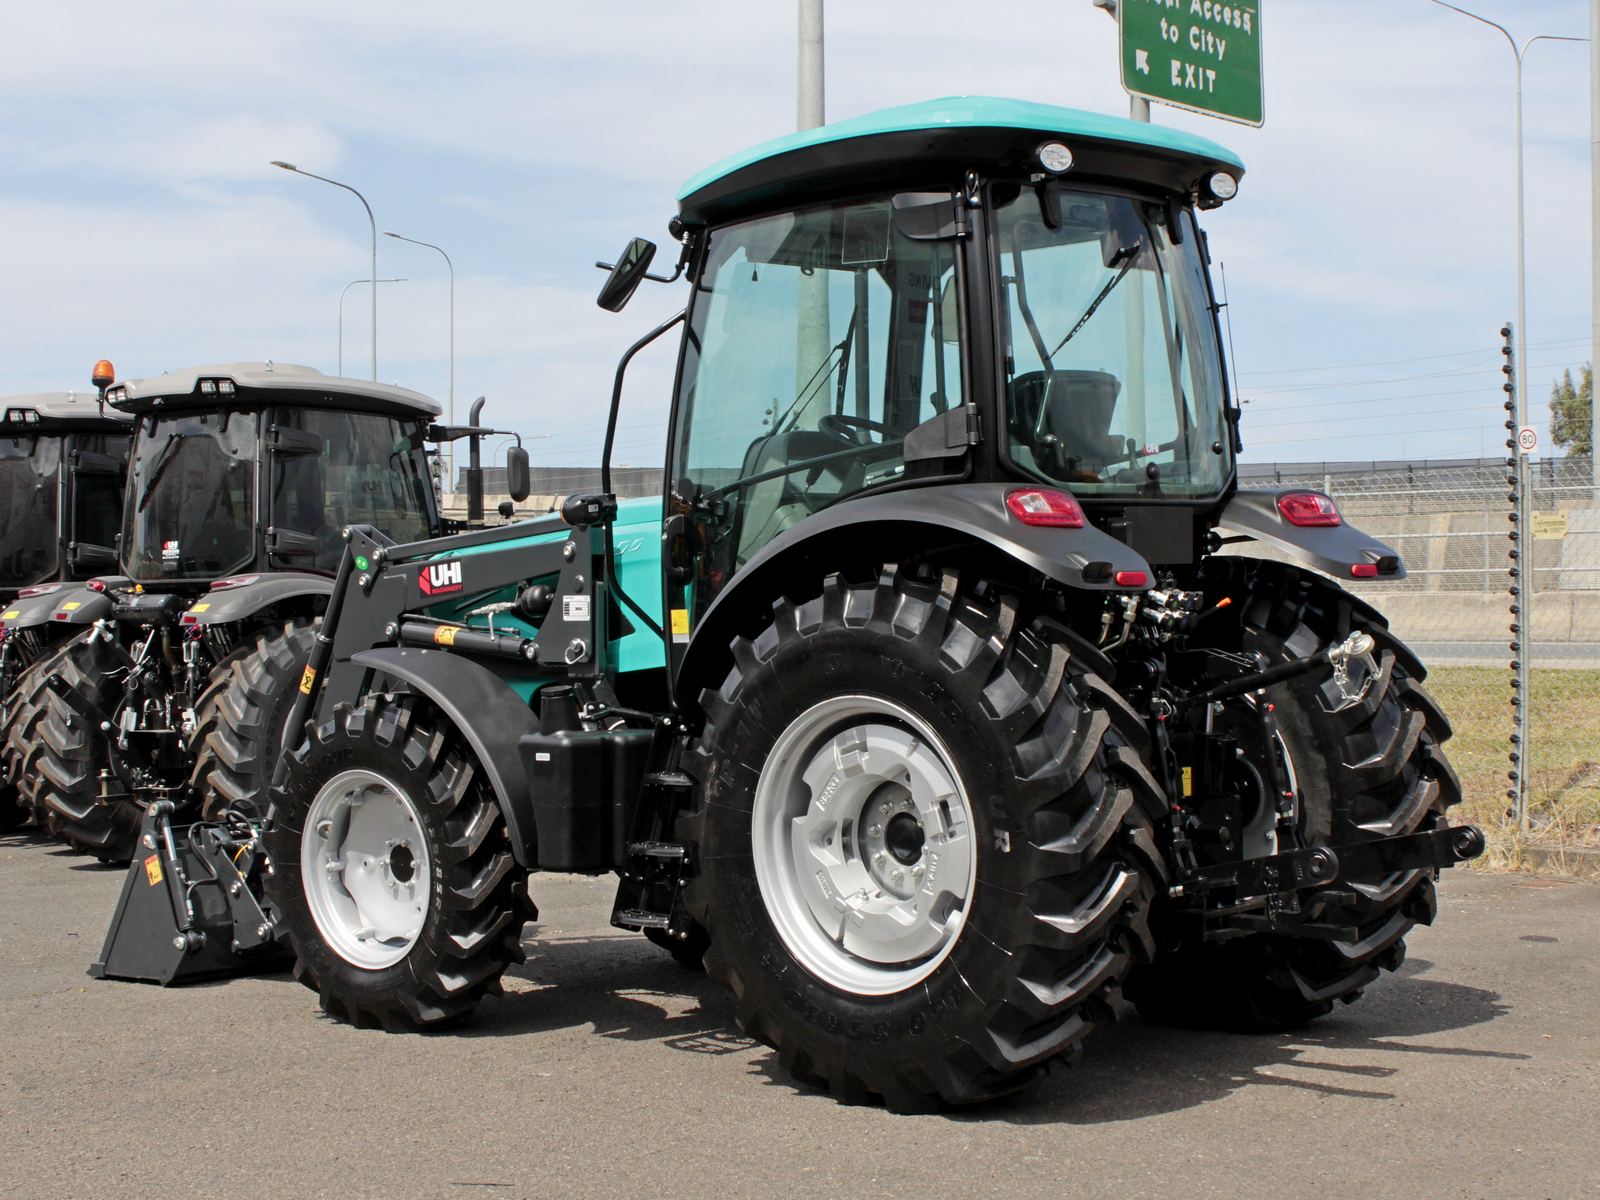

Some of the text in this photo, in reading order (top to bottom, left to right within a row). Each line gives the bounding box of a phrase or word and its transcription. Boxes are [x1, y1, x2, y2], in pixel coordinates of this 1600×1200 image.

[1160, 17, 1226, 61] to City
[1171, 59, 1216, 93] EXIT
[430, 561, 462, 587] UHI
